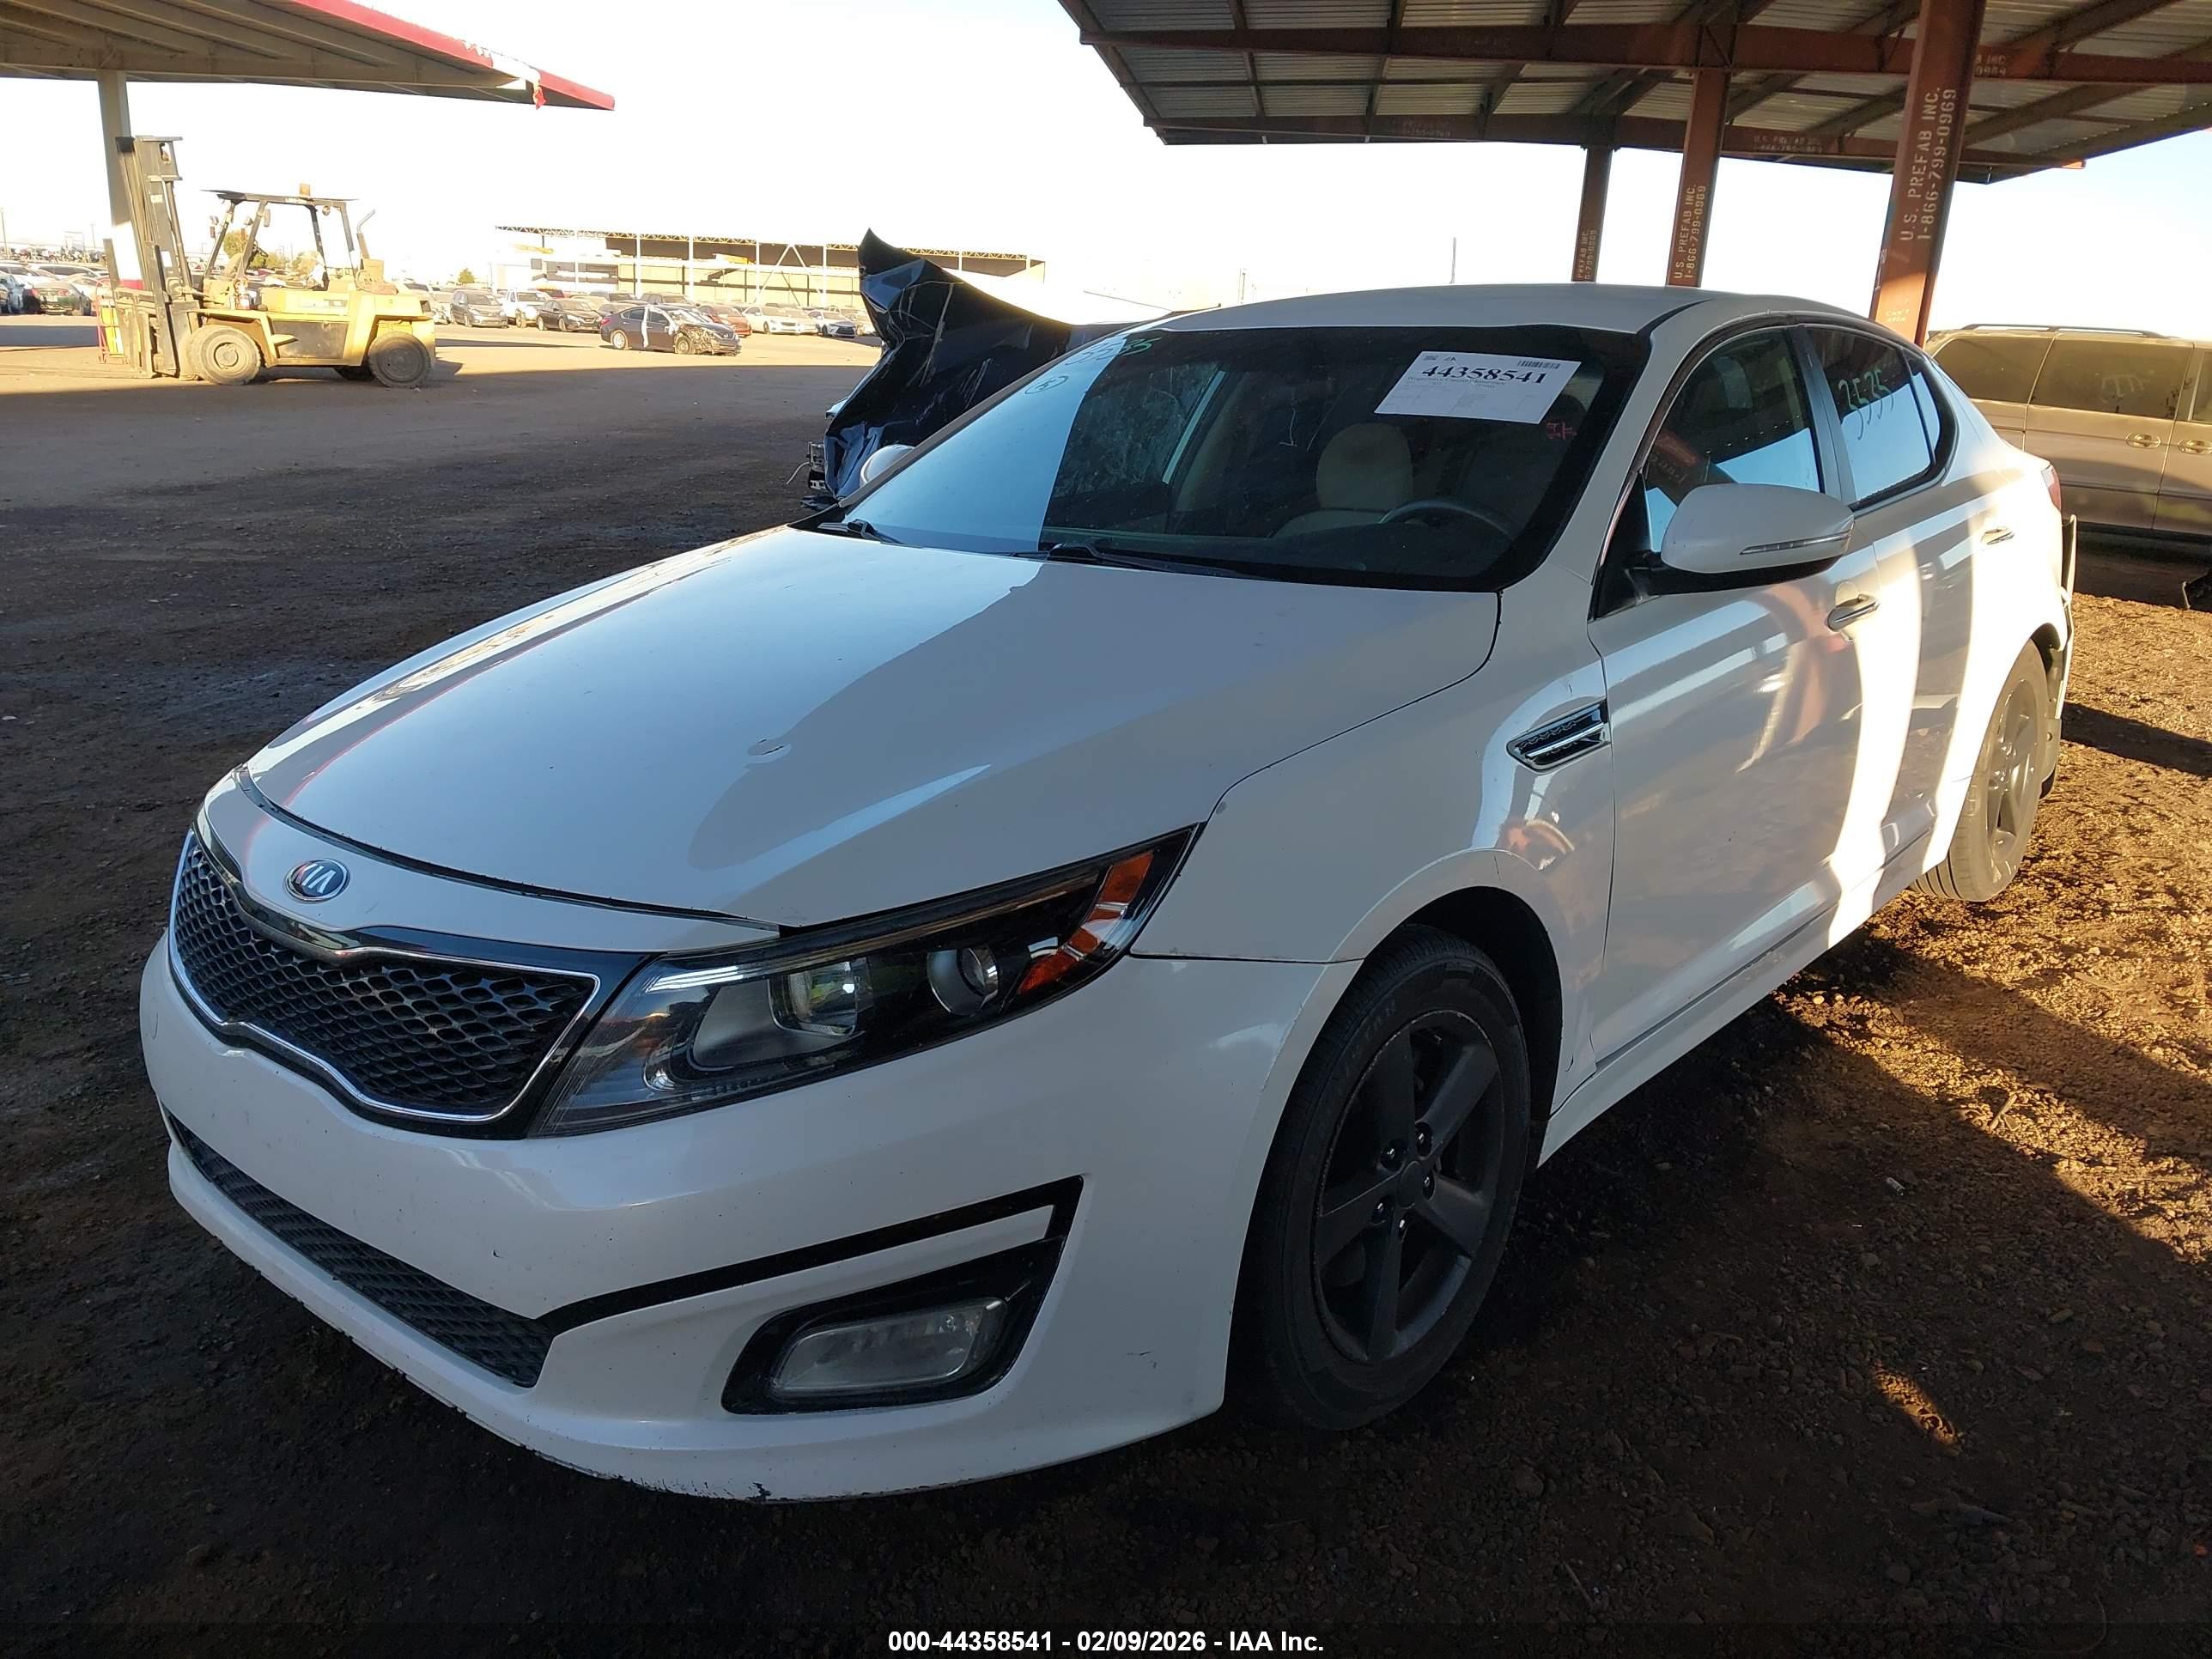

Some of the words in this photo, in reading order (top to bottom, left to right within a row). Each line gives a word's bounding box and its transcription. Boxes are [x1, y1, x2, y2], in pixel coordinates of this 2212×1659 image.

[1922, 87, 1941, 120] INC.
[1907, 131, 1932, 198] PREFAB
[1917, 88, 1957, 240] 1-866-799-0969
[1685, 184, 1697, 205] INC.
[1678, 210, 1692, 252] PREFAB
[1684, 185, 1706, 278] 1-866-799-0969
[1899, 209, 1918, 240] U.S.
[1674, 258, 1686, 279] U.S.
[1421, 365, 1547, 384] 44358541
